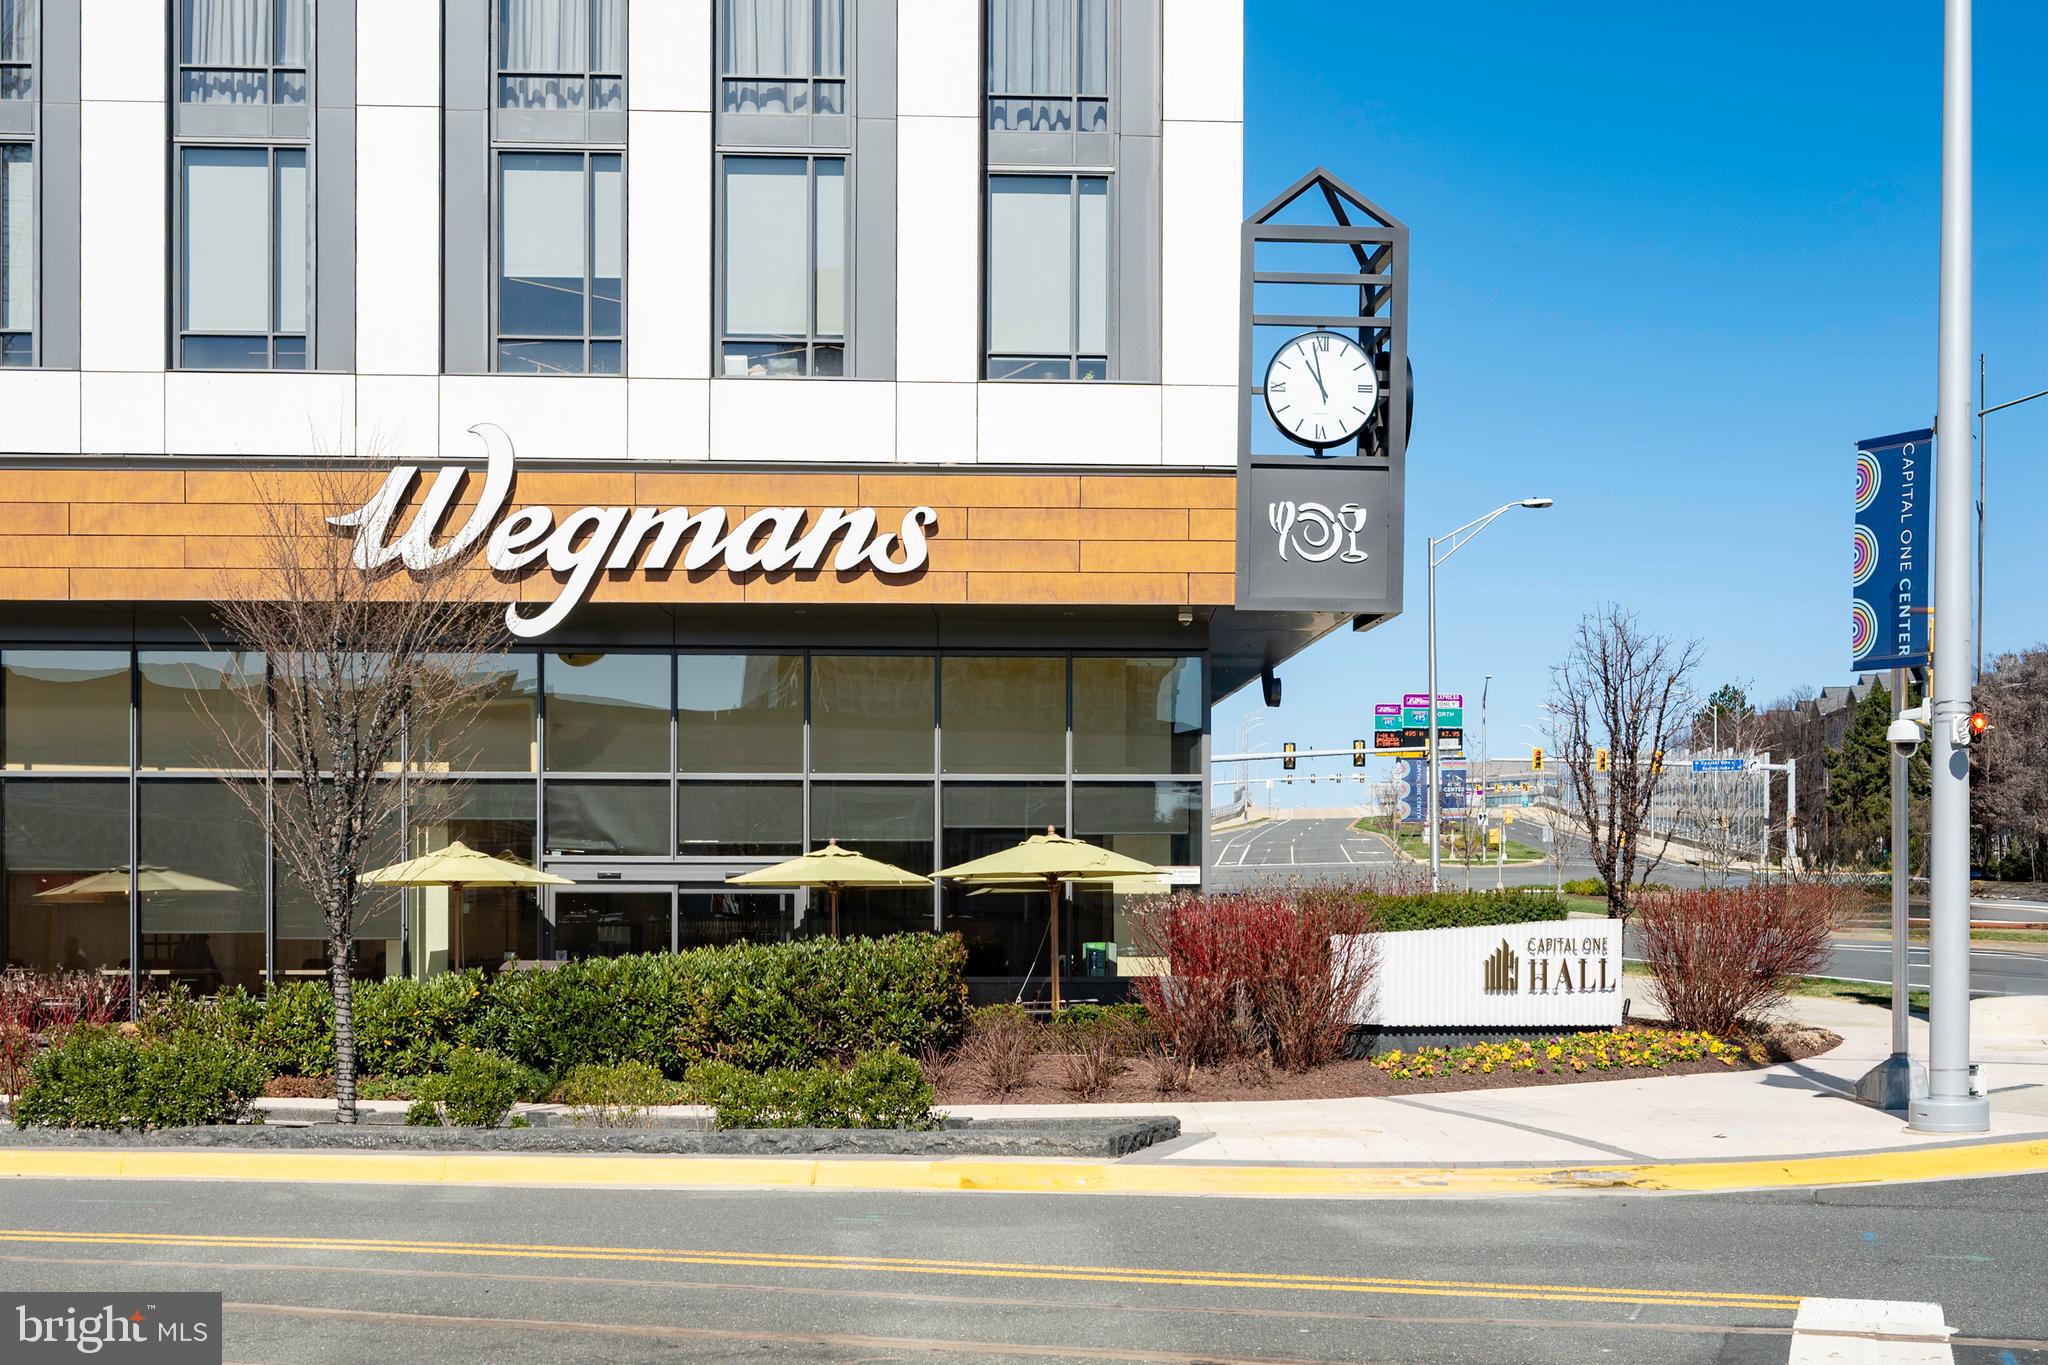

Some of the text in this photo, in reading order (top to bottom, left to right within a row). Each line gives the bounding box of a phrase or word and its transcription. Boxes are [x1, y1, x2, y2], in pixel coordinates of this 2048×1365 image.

[326, 422, 937, 638] Wegmans
[1898, 442, 1915, 656] CAPITAL ONE CENTER
[1527, 937, 1609, 952] CAPITAL ONE
[1528, 957, 1617, 993] HALL
